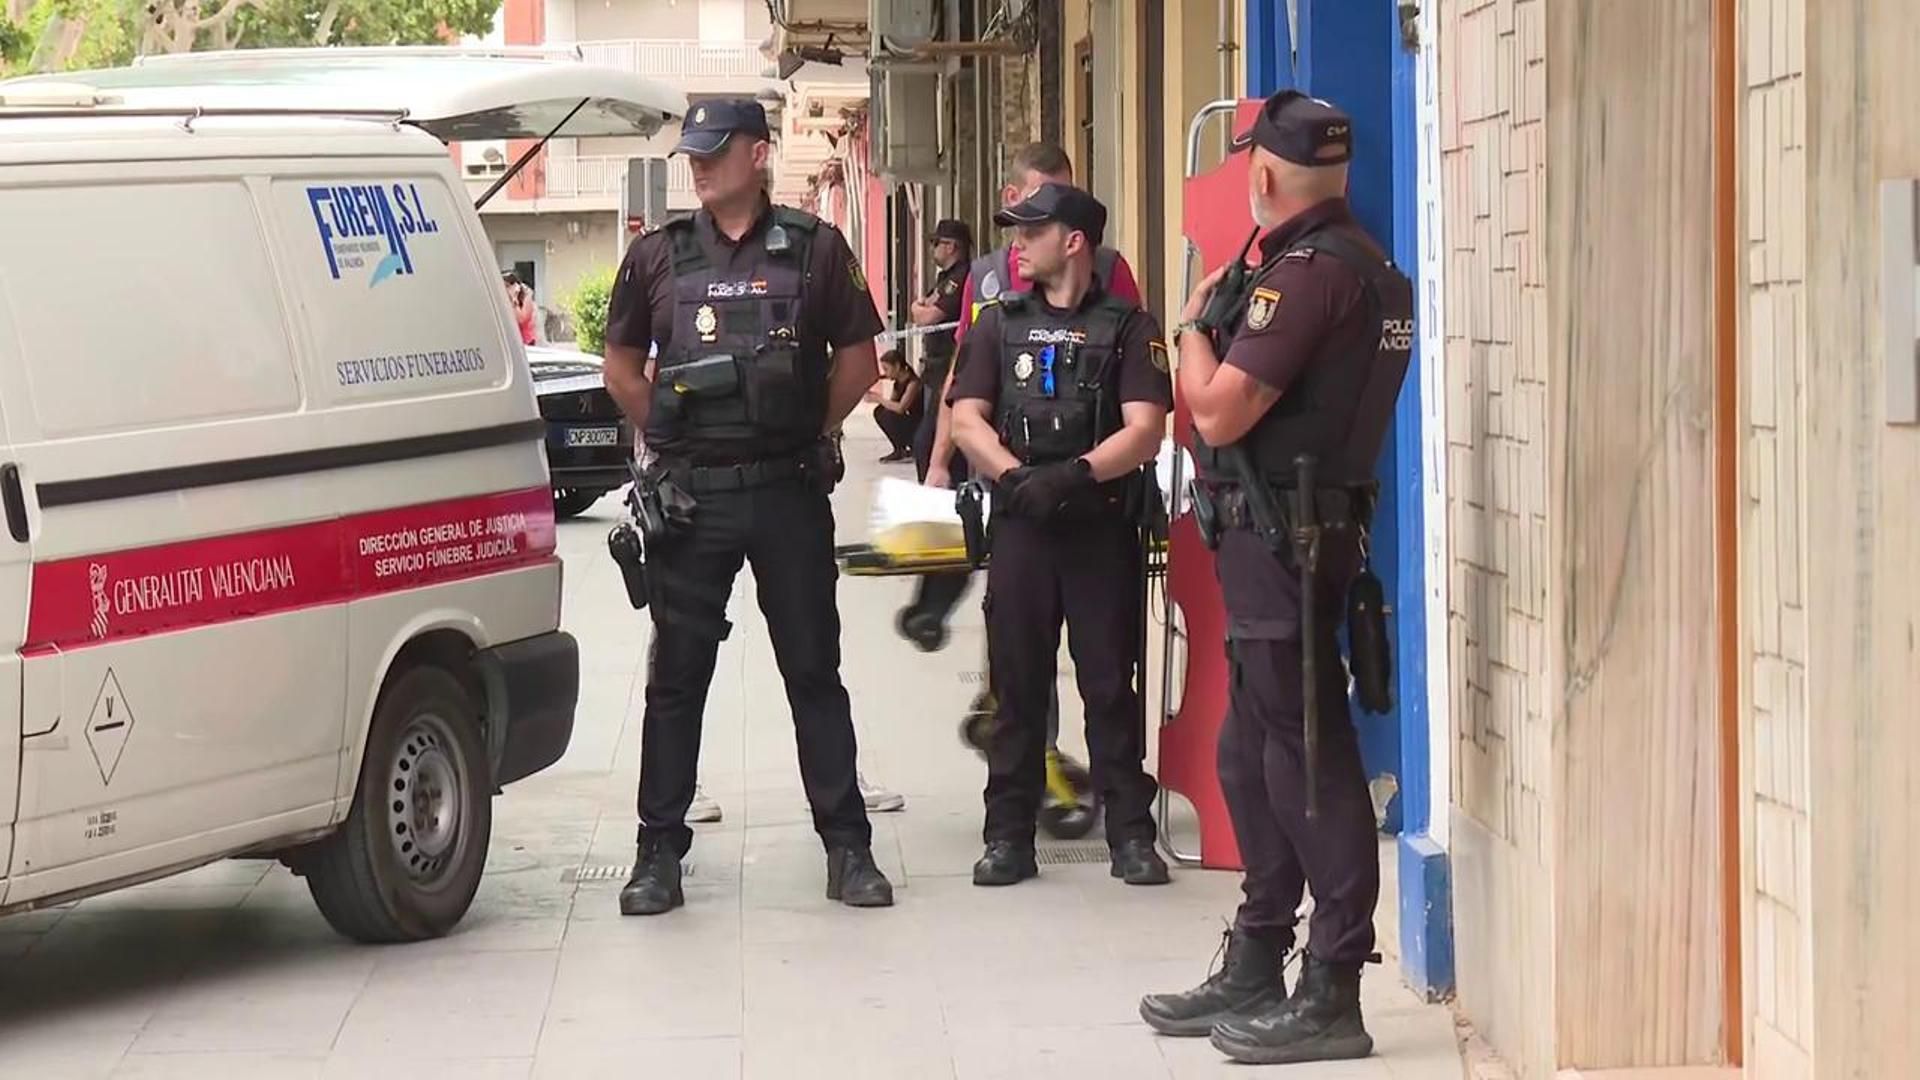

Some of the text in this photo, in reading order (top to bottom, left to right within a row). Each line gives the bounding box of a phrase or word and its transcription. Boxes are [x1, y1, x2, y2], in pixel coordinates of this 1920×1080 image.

[336, 347, 486, 386] SERVICIOS FUNERARIOS
[359, 511, 527, 556] DIRECCIÓN GENERAL DE JUSTICIA
[374, 537, 518, 577] SERVICIO FÚNEBRE JUDICIAL
[114, 554, 296, 616] GENERALITAT VALENCIANA
